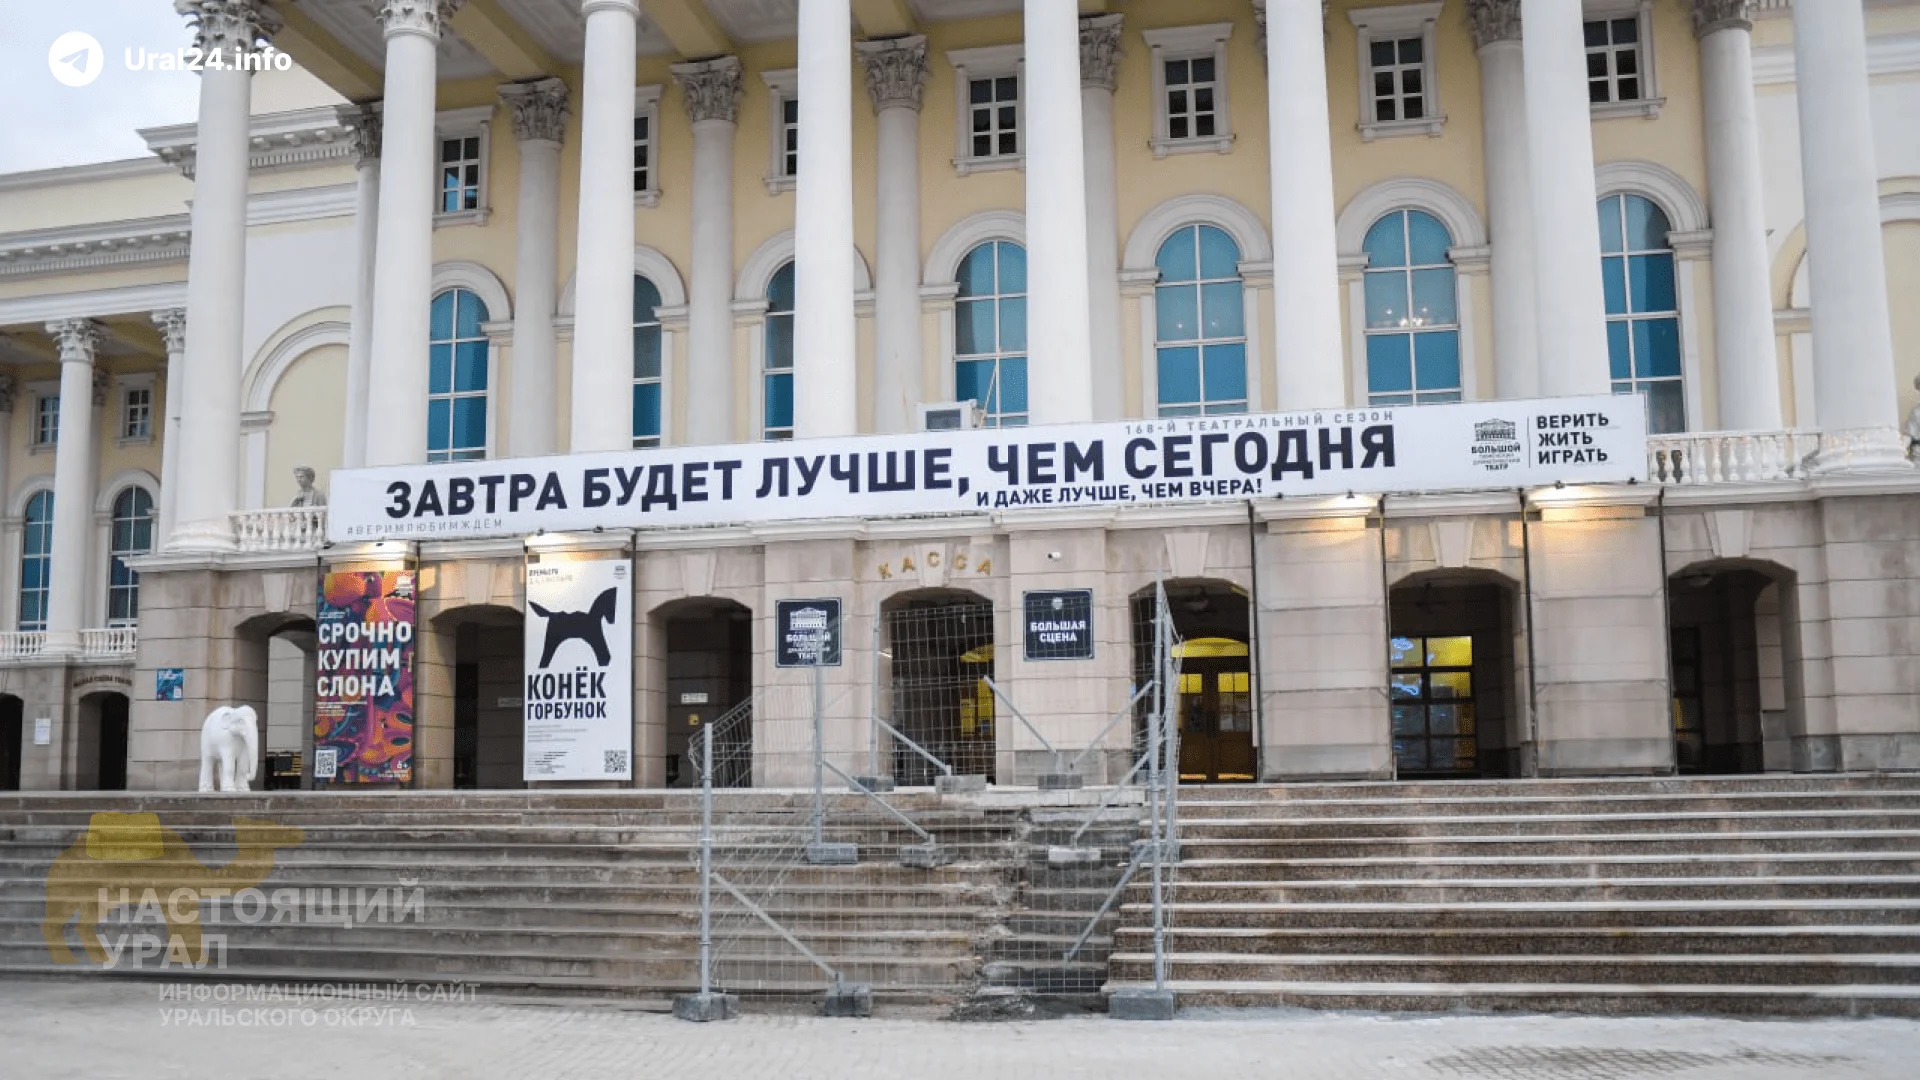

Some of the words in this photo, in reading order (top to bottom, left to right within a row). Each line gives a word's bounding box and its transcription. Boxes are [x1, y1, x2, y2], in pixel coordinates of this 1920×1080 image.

[1125, 421, 1176, 435] 168-Й
[1188, 412, 1323, 431] ТЕАТРАЛЬНЫЙ
[1334, 410, 1393, 424] СЕЗОН
[1536, 412, 1609, 429] ВЕРИТЬ
[1471, 441, 1521, 454] БОЛЬШОЙ
[1538, 431, 1593, 447] ЖИТЬ
[1538, 448, 1608, 465] ИГРАТЬ
[386, 471, 567, 518] ЗАВТРА
[583, 460, 742, 512] БУДЕТ
[756, 448, 969, 498] ЛУЧШЕ,
[988, 439, 1105, 485] ЧЕМ
[1124, 425, 1395, 481] СЕГОДНЯ
[976, 492, 989, 507] И
[994, 488, 1053, 508] ДАЖЕ
[1057, 484, 1137, 503] ЛУЧШЕ,
[1141, 482, 1183, 499] ЧЕМ
[1189, 478, 1264, 496] ВЧЕРА!
[877, 550, 992, 580] КАССА
[318, 620, 412, 644] СРОЧНО
[1030, 620, 1087, 632] БОЛЬШАЯ
[1039, 631, 1078, 644] СЦЕНА
[317, 647, 400, 671] КУПИМ
[317, 674, 395, 697] СЛОНА
[527, 666, 607, 701] КОНЁК
[527, 701, 607, 720] ГОРБУНОК
